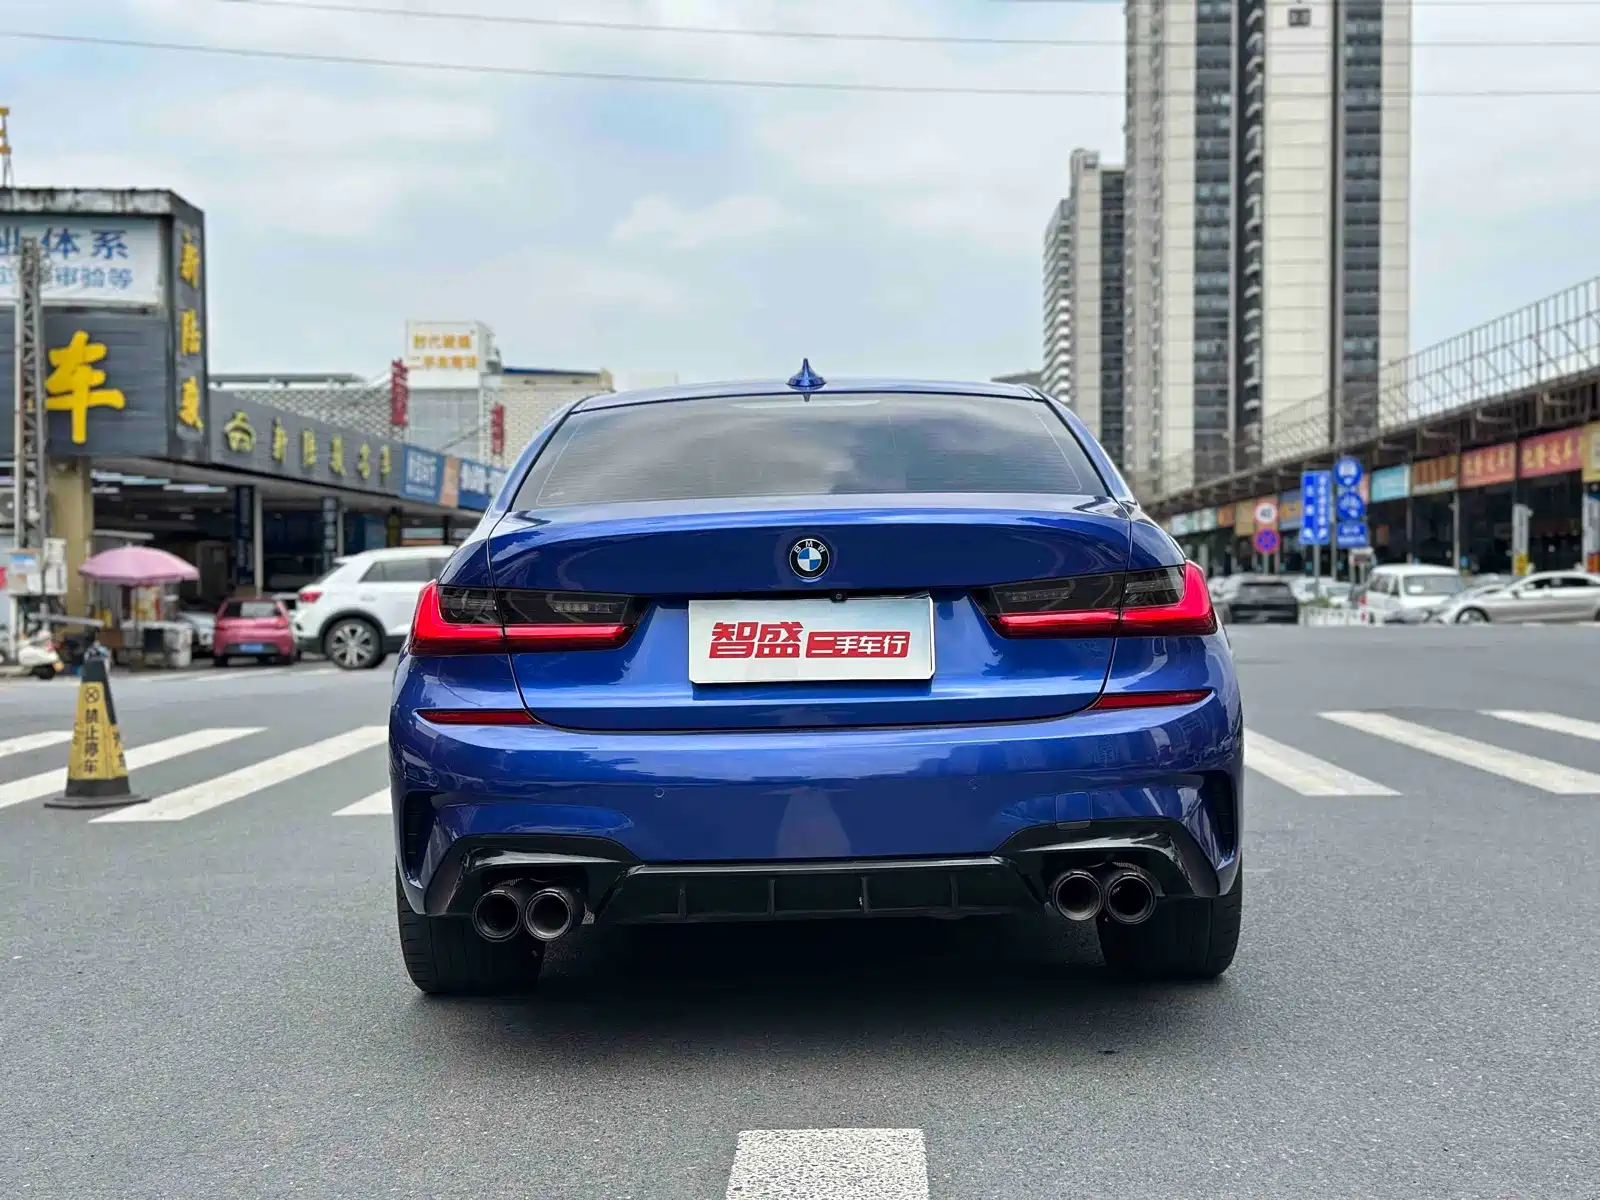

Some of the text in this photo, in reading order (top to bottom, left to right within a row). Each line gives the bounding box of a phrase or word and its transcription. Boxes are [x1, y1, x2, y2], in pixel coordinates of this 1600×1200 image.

[793, 540, 826, 553] BMW
[709, 621, 908, 659] 智盛 二手车行
